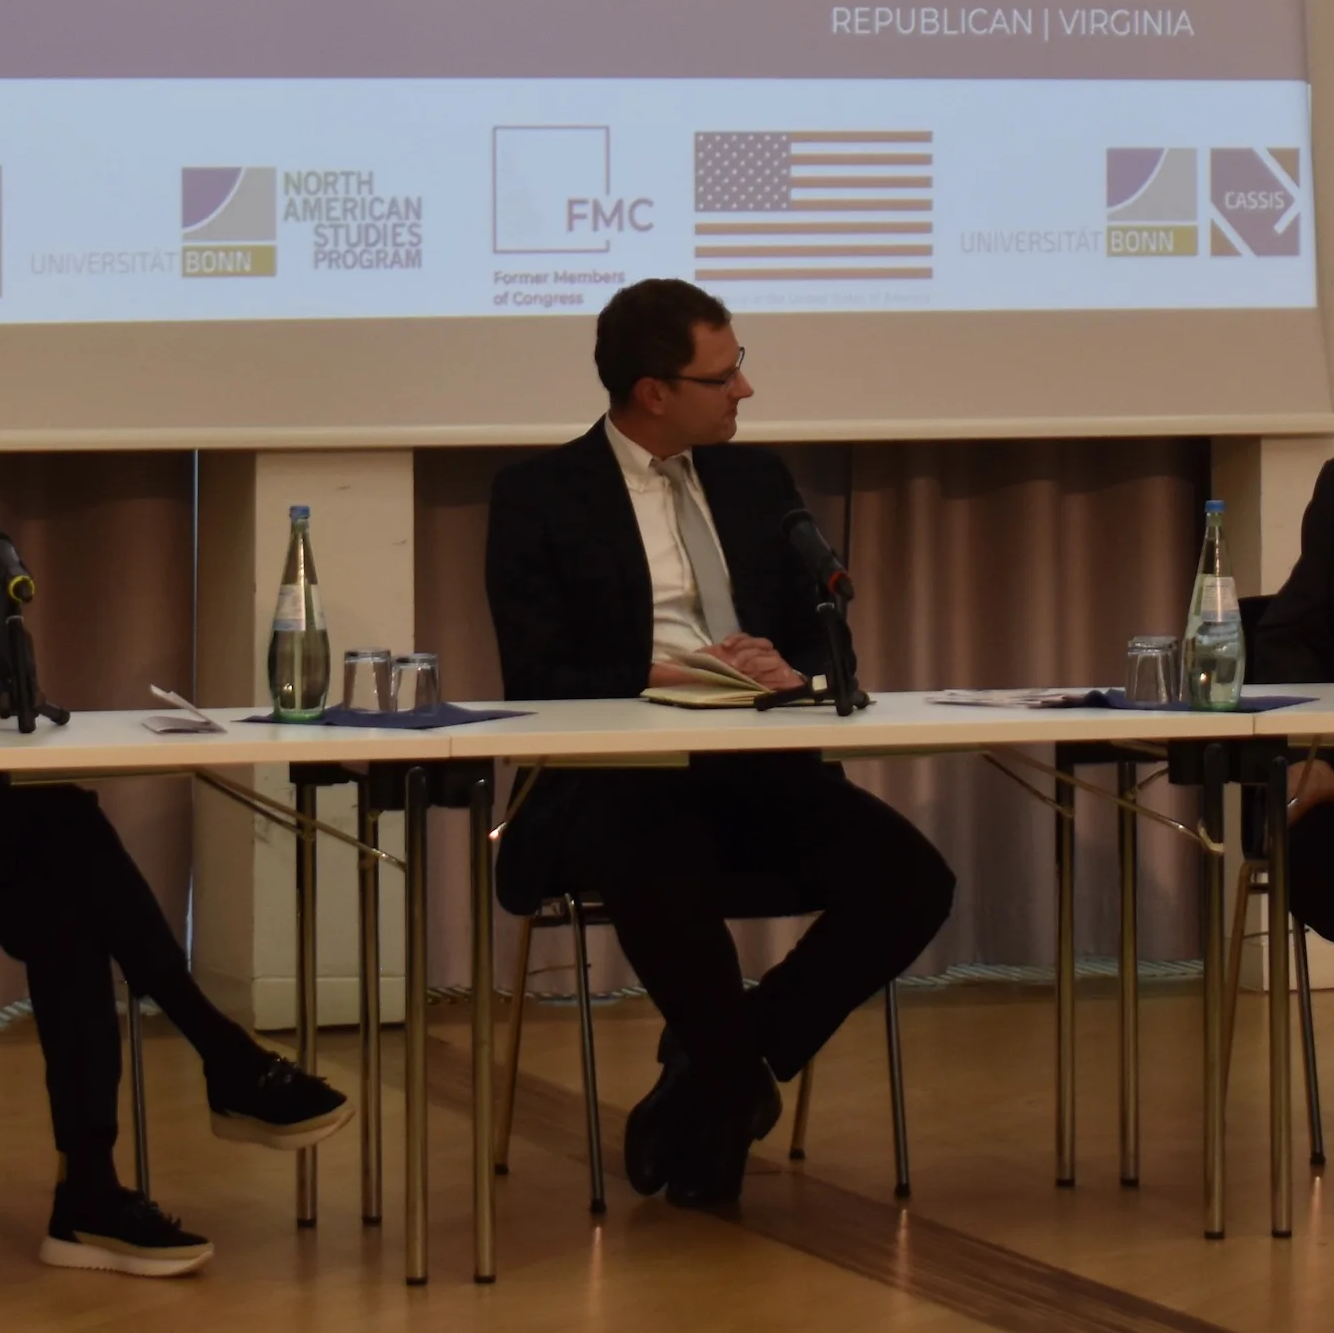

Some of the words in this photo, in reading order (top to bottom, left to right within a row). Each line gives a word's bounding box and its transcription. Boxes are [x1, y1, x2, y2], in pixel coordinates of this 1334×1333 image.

[831, 7, 1033, 35] REPUBLICAN
[1059, 9, 1195, 36] VIRGINIA
[283, 171, 374, 196] NORTH
[283, 196, 422, 222] AMERICAN
[1223, 191, 1286, 210] CASSIS
[567, 197, 655, 233] FMC
[313, 223, 422, 248] STUDIES
[960, 225, 1103, 254] UNIVERSITÄT
[1110, 230, 1174, 254] BONN
[30, 247, 177, 276] UNIVERSITÄT
[184, 250, 252, 273] BONN
[313, 248, 422, 270] PROGRAM
[493, 270, 549, 284] Former
[554, 269, 626, 284] Members
[493, 292, 508, 306] of
[512, 292, 584, 308] Congress
